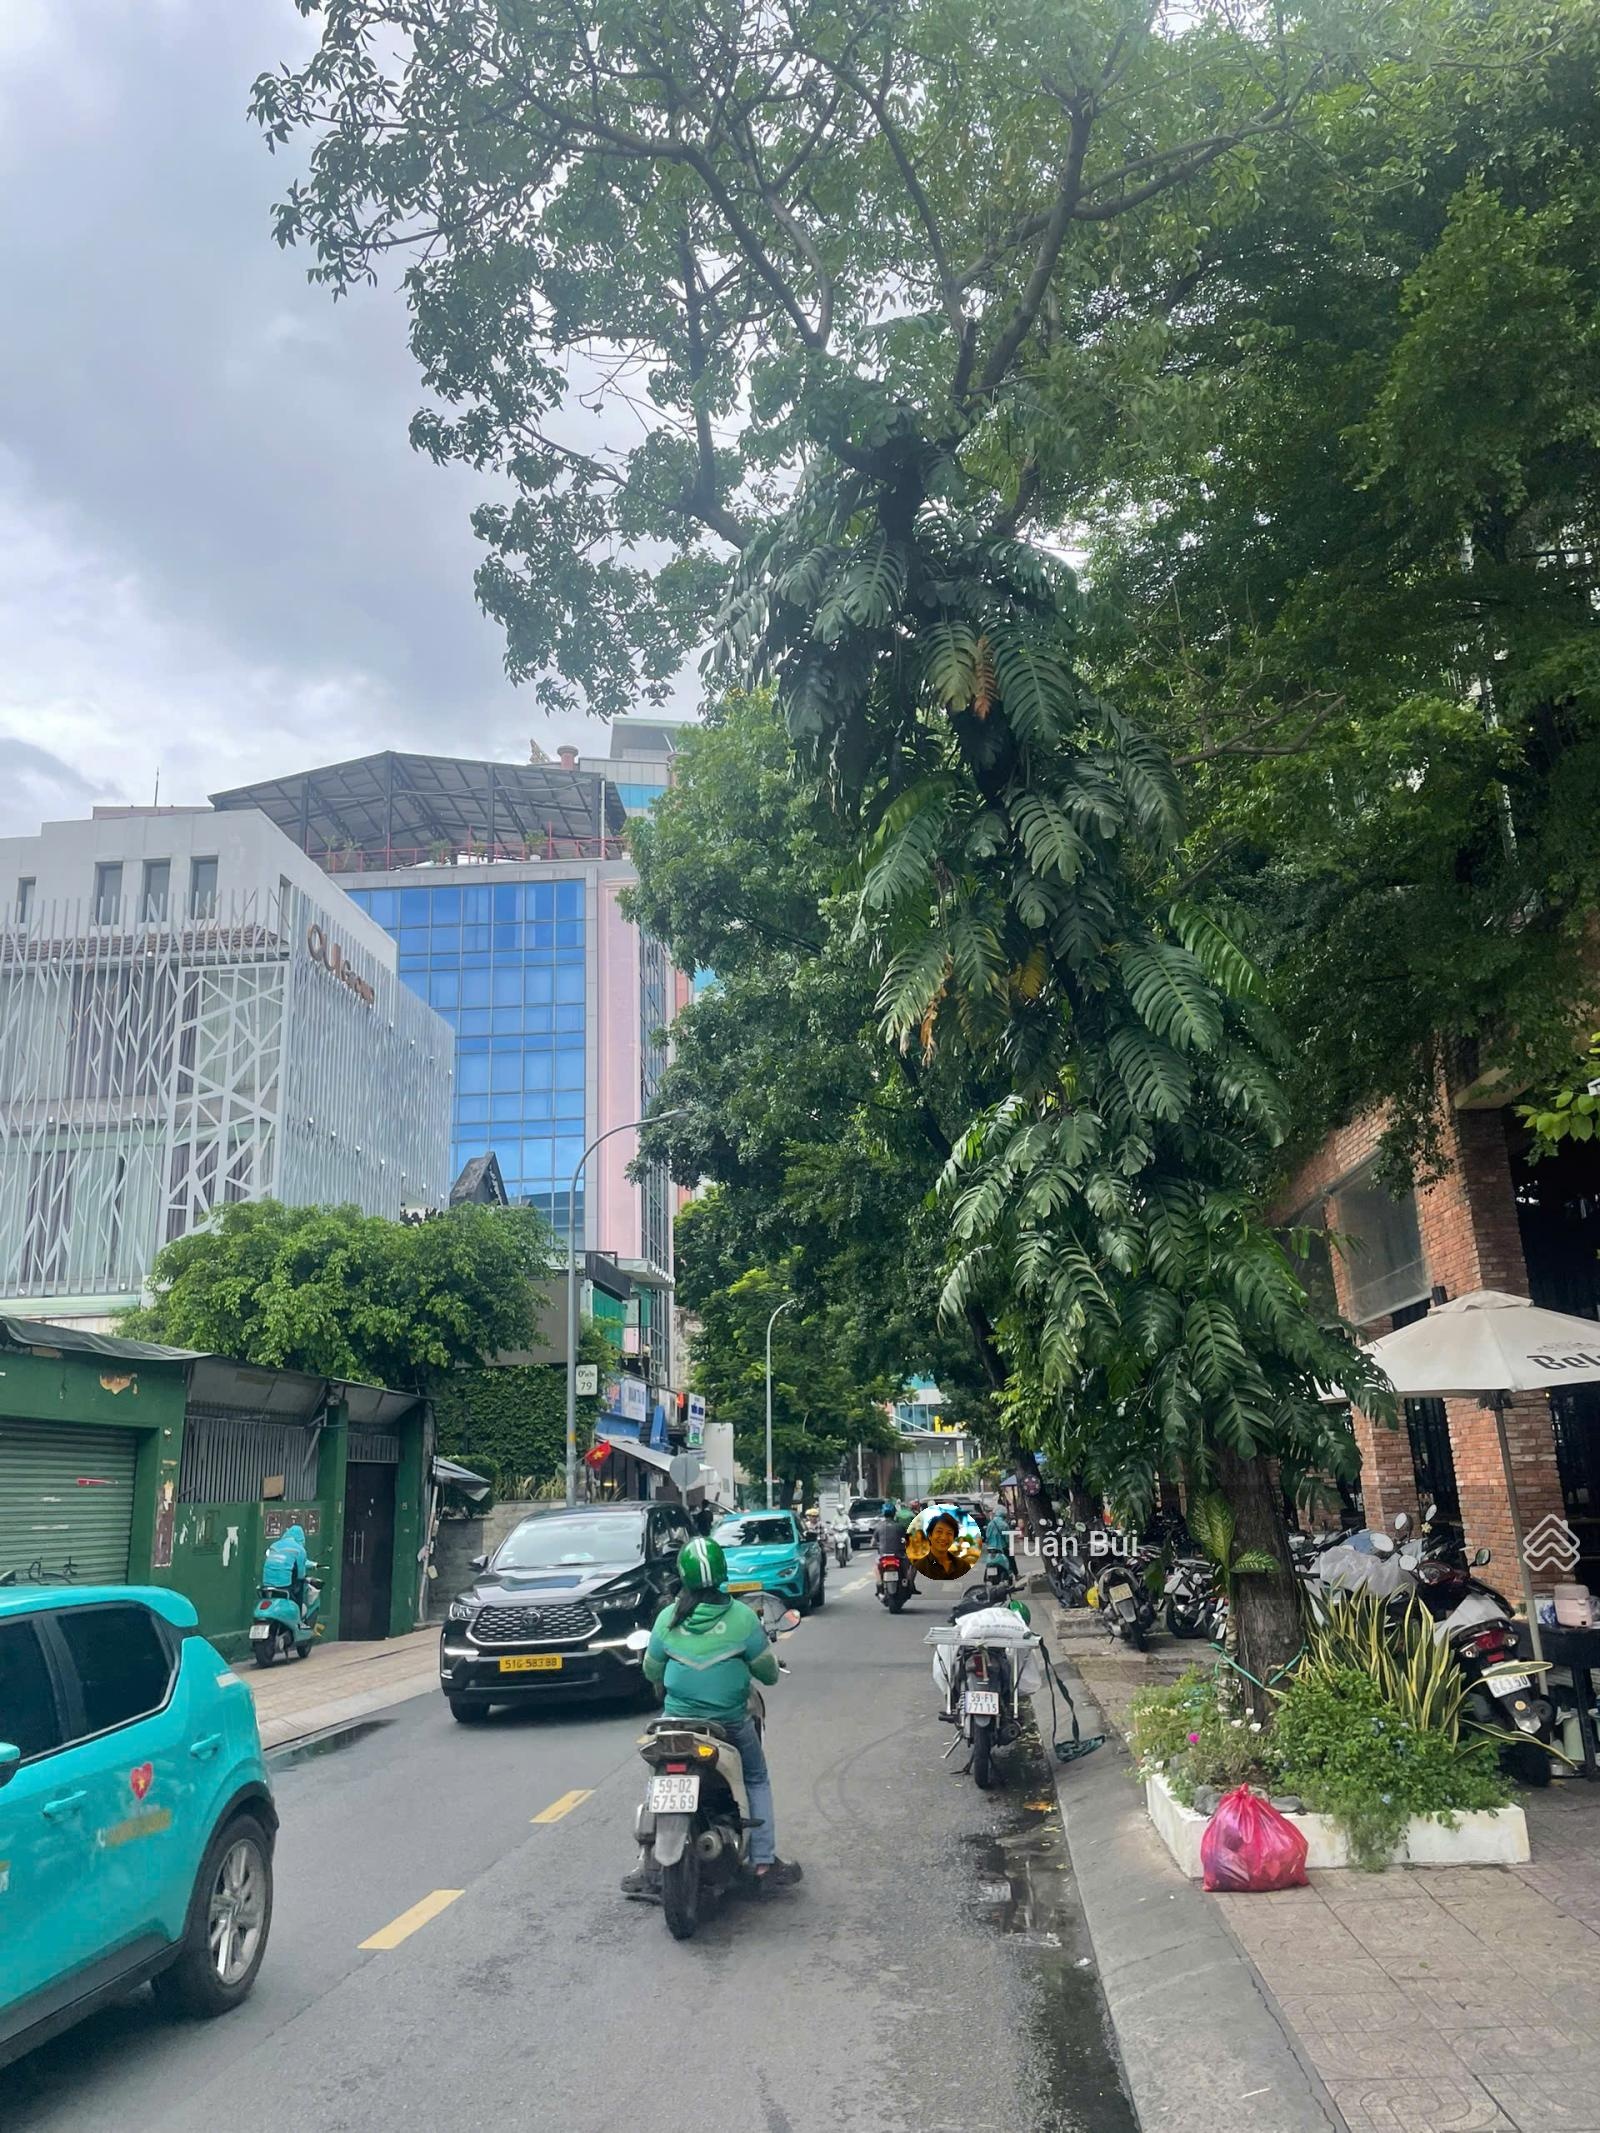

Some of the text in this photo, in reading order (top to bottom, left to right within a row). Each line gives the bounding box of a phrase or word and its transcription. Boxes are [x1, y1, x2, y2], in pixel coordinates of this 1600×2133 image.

[1526, 1353, 1600, 1370] Bel
[581, 1381, 593, 1391] 79
[659, 1778, 692, 1793] 59-D2
